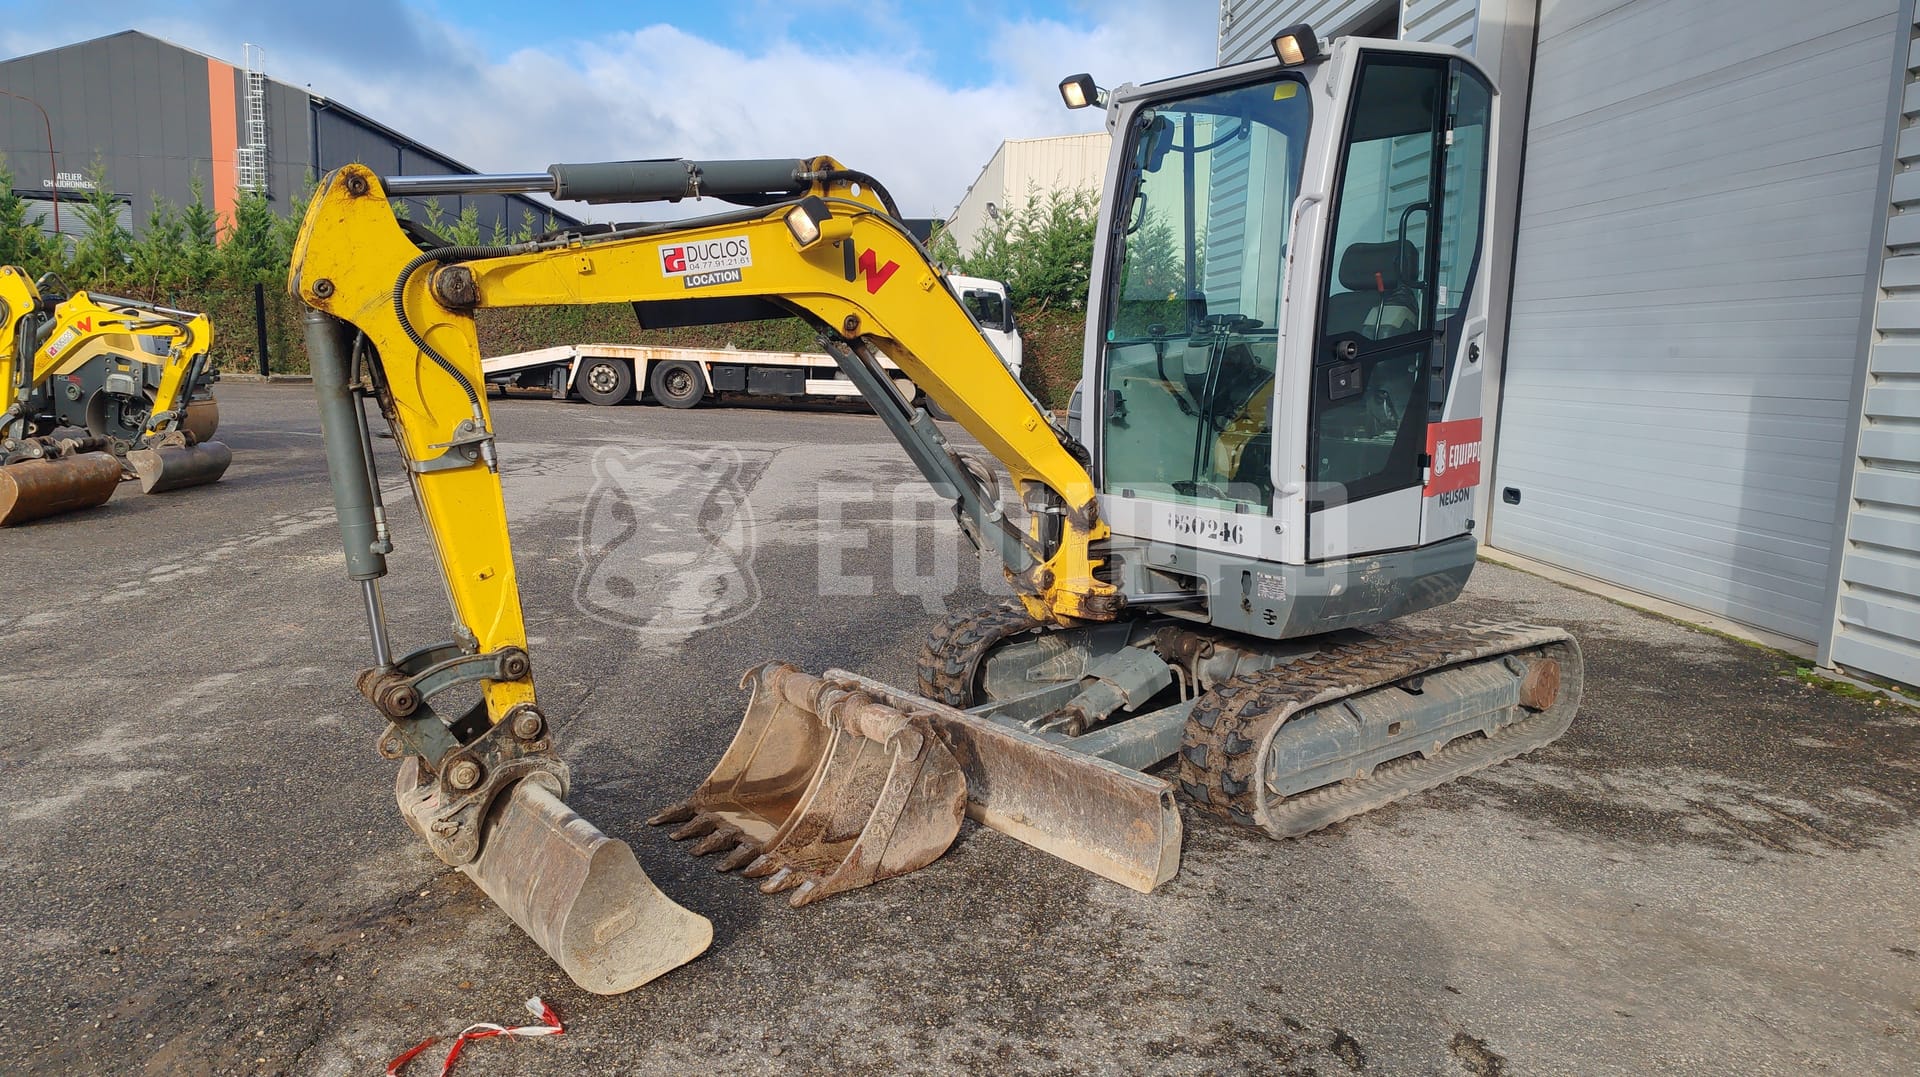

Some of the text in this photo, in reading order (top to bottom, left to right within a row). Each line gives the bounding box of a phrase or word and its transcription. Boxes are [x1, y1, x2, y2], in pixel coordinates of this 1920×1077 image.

[57, 172, 82, 181] ATELIER
[687, 239, 748, 263] DUCLOS
[690, 257, 750, 271] 04.77.91.21.61
[686, 270, 740, 287] LOCATION
[1439, 487, 1470, 508] NEUSON
